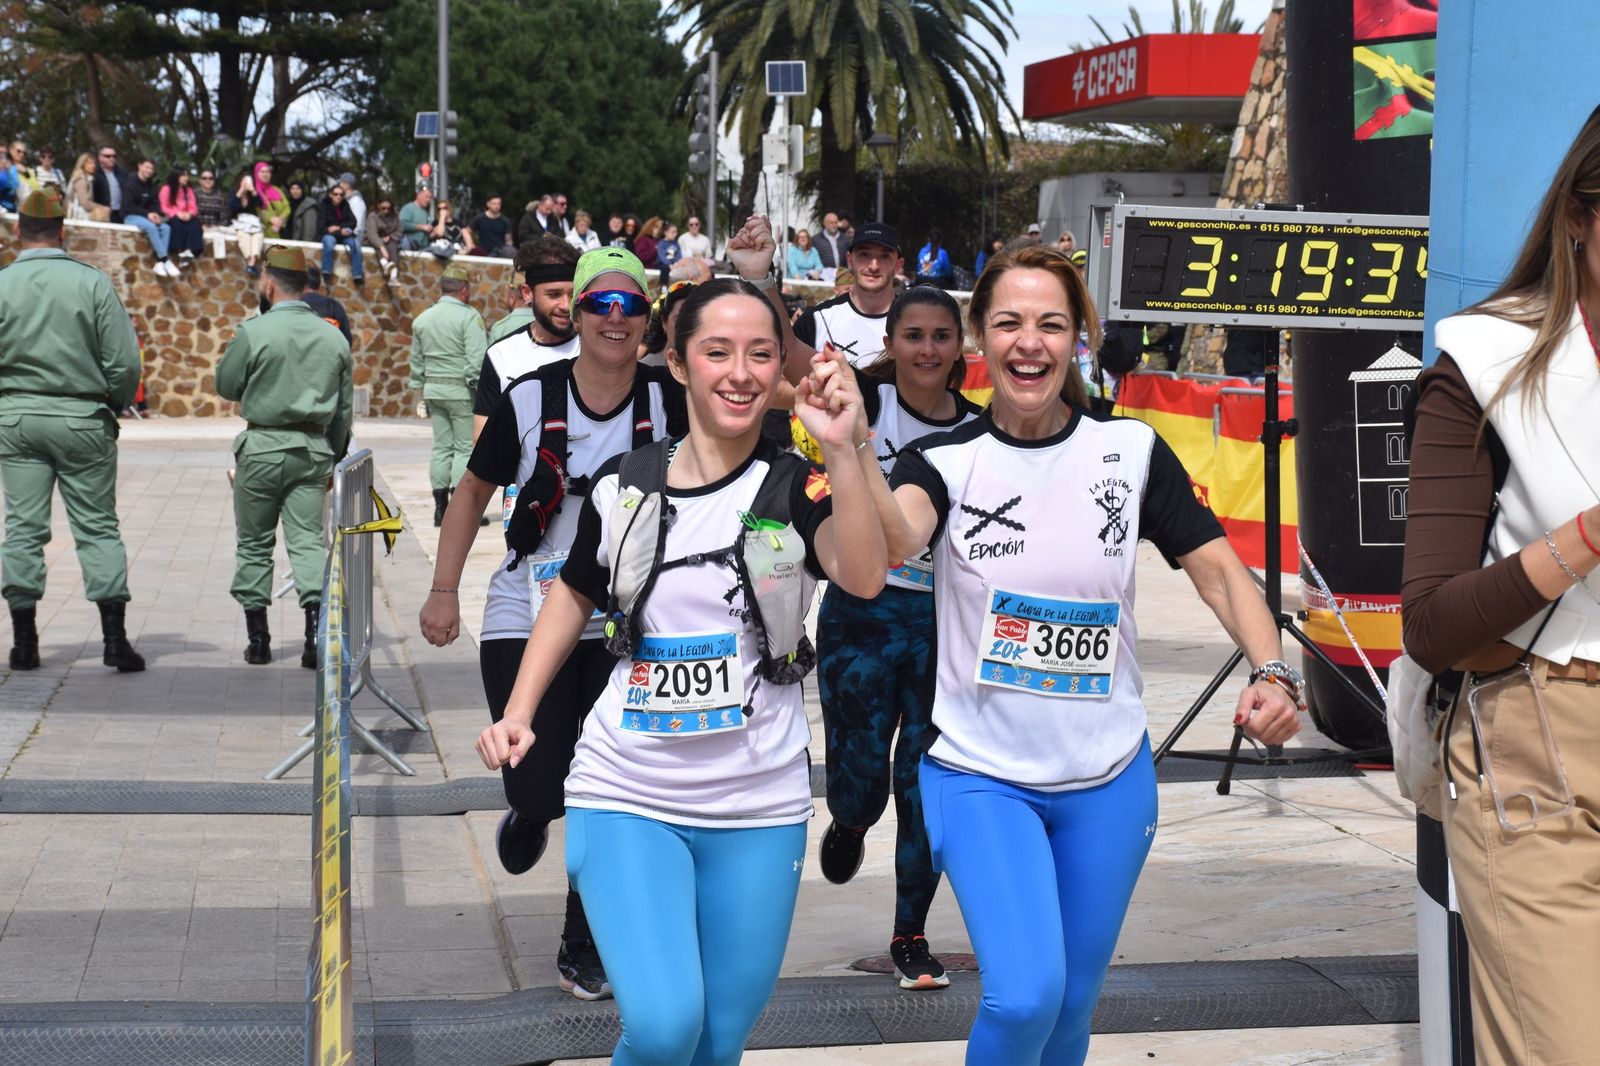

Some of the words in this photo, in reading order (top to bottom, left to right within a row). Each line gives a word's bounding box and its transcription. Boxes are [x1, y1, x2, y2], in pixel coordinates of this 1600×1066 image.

[1087, 46, 1137, 100] CEPSA
[1149, 219, 1251, 230] www.gesconchip.es
[1260, 223, 1280, 232] 615
[1282, 224, 1302, 233] 980
[1305, 225, 1324, 234] 784
[1146, 300, 1247, 312] www.gesconchip.es
[1255, 304, 1275, 313] 615
[1278, 305, 1297, 314] 980
[1300, 305, 1319, 315] 784
[969, 537, 1025, 560] EDICIÓN
[989, 639, 1029, 661] 20K
[1033, 624, 1111, 661] 3666
[654, 660, 729, 698] 2091
[627, 686, 652, 706] 20K
